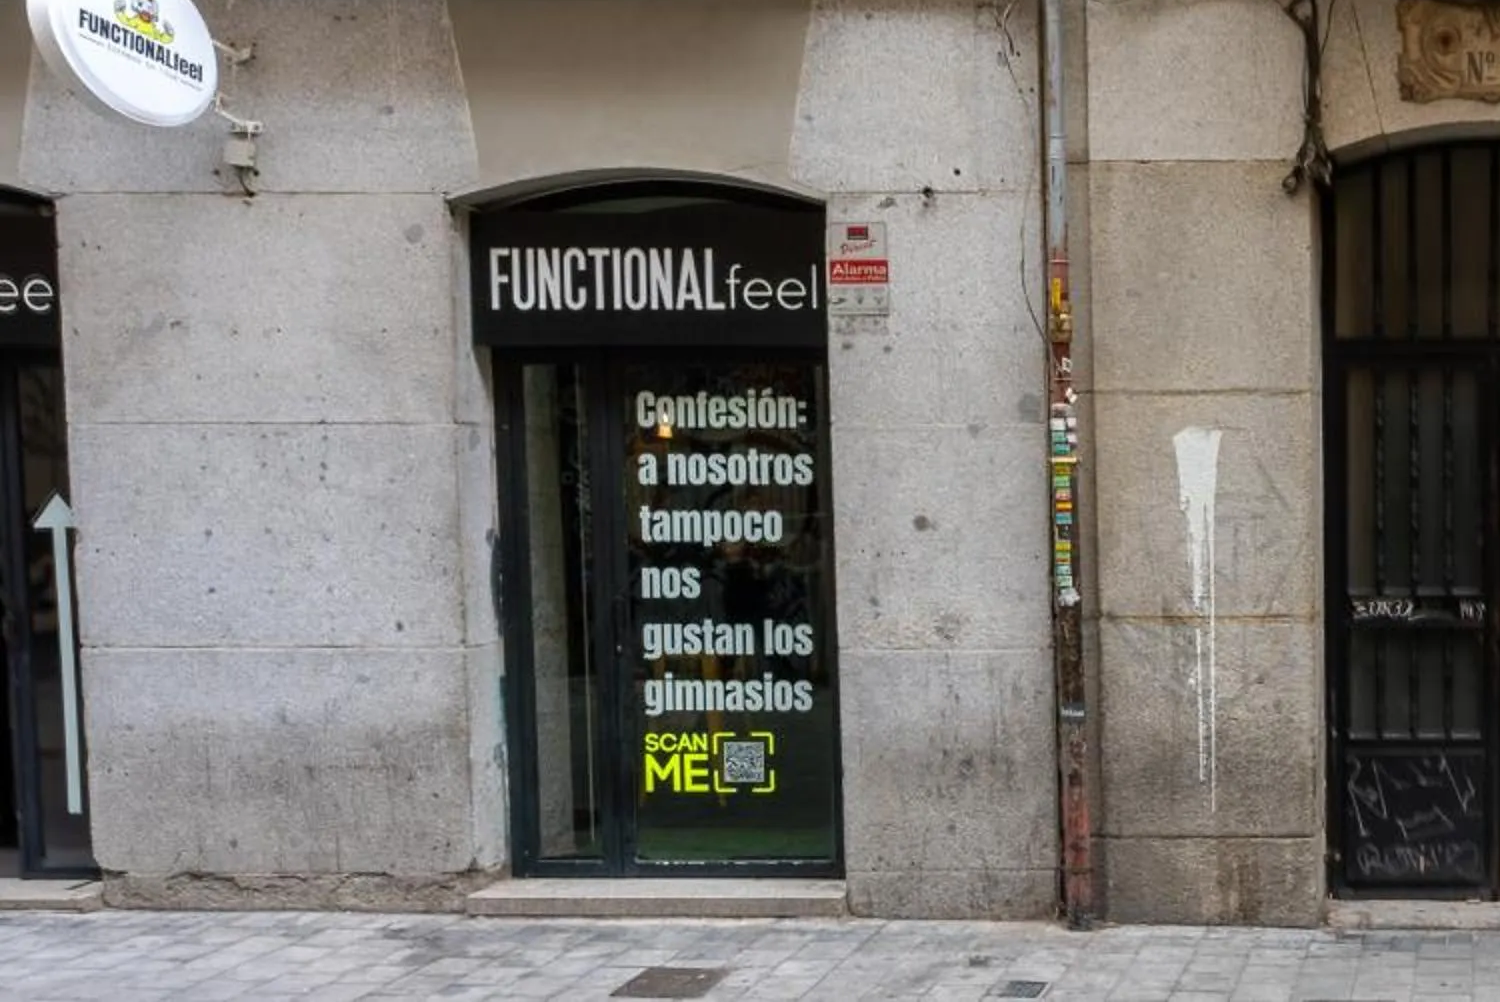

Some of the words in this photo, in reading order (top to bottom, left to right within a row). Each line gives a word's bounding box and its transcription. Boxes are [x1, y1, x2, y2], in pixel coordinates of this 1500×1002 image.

[832, 262, 887, 275] Alarma
[636, 388, 807, 430] Confesión:
[638, 455, 658, 486] a
[667, 451, 814, 486] nosotros
[640, 505, 783, 547] tampoco
[642, 567, 700, 599] nos
[643, 621, 754, 660] gustan
[763, 619, 813, 656] los
[645, 674, 812, 717] gimnasios
[645, 733, 708, 752] SCAN
[645, 754, 709, 793] ME
